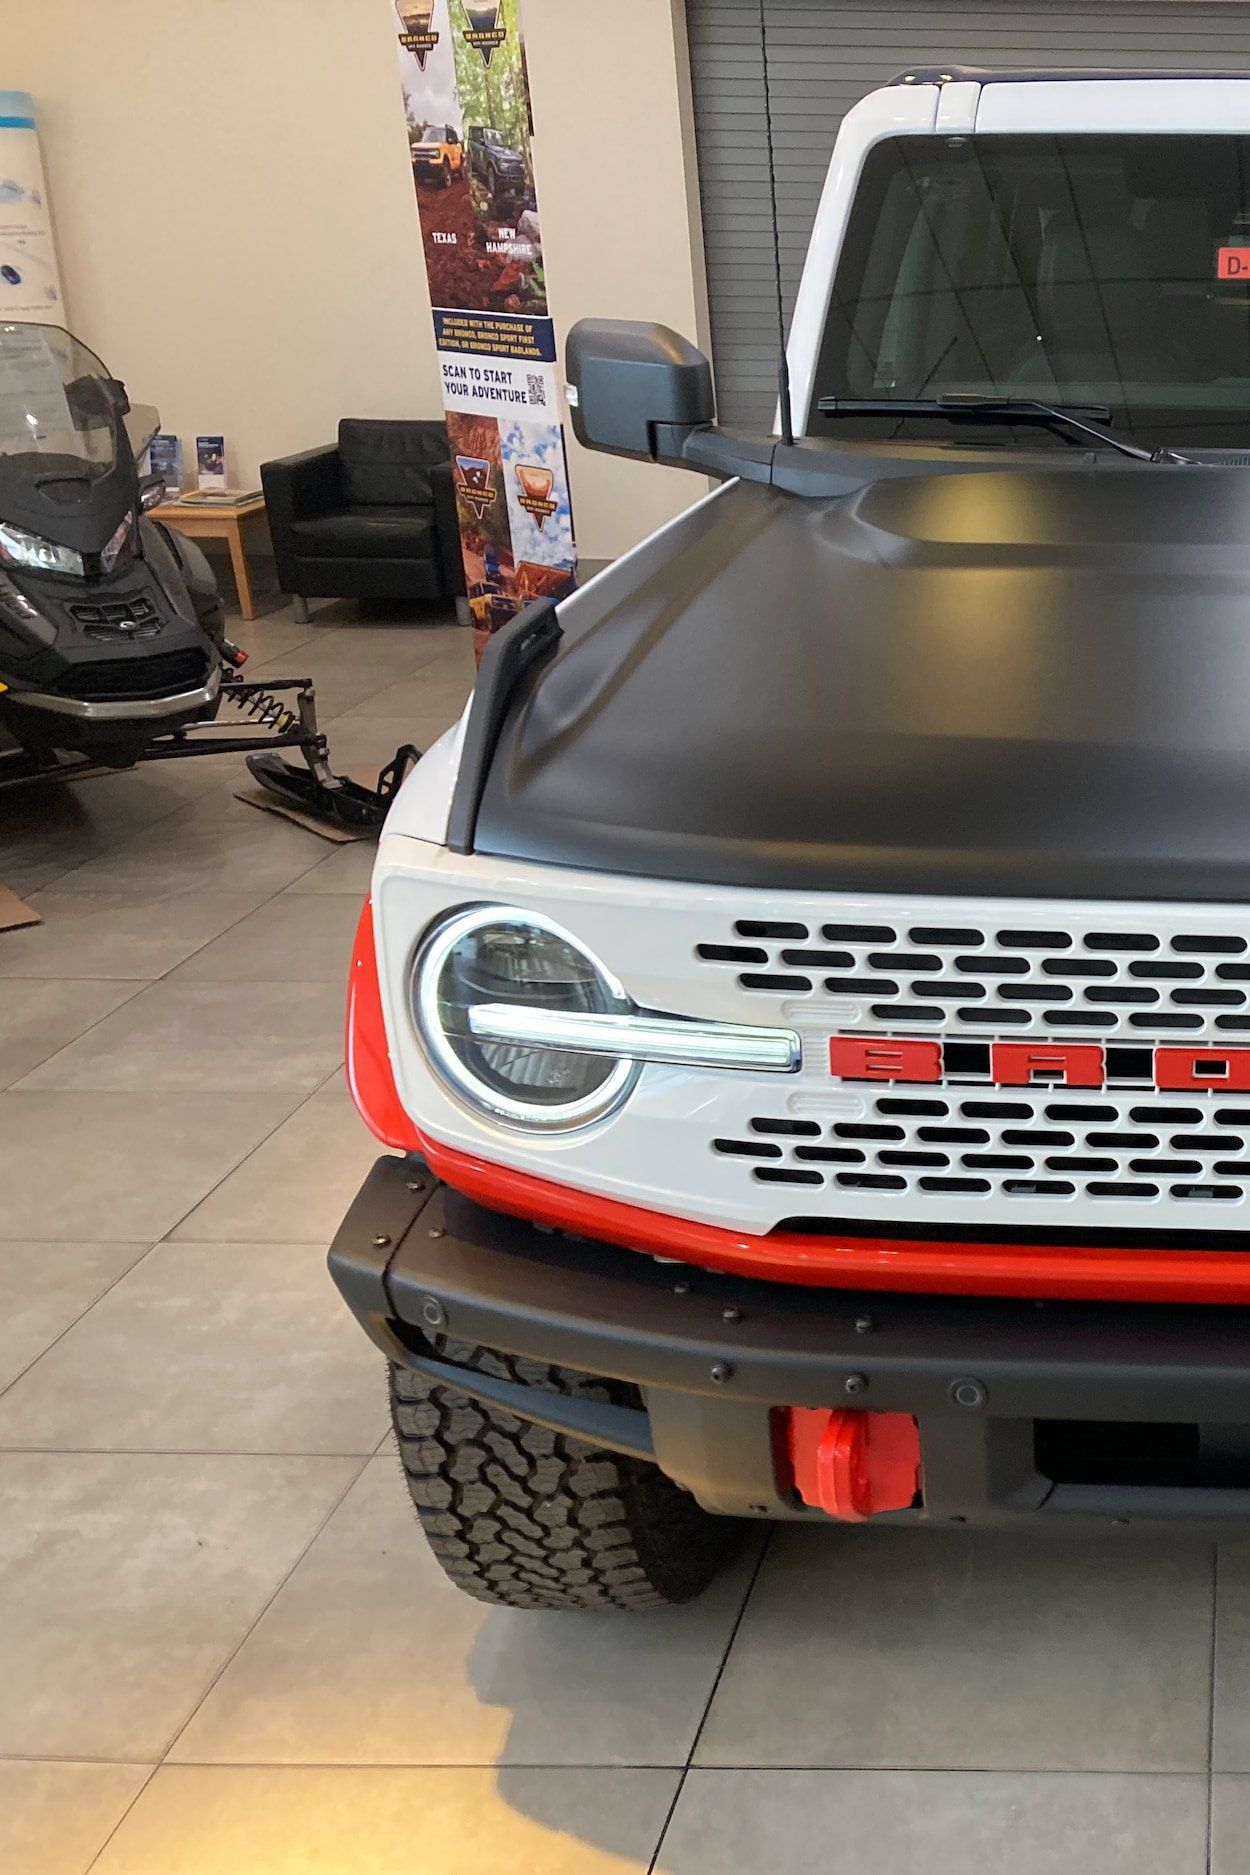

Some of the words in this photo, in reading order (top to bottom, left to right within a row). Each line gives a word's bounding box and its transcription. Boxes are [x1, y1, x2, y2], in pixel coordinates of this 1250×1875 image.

[432, 232, 457, 245] TEXAS
[498, 227, 516, 240] NEW
[486, 242, 532, 256] HAMPSHIRE
[443, 317, 468, 326] INCLUDED
[443, 364, 466, 378] SCAN
[469, 368, 480, 380] TO
[484, 370, 512, 384] START
[445, 382, 469, 396] YOUR
[472, 385, 527, 404] ADVENTURE
